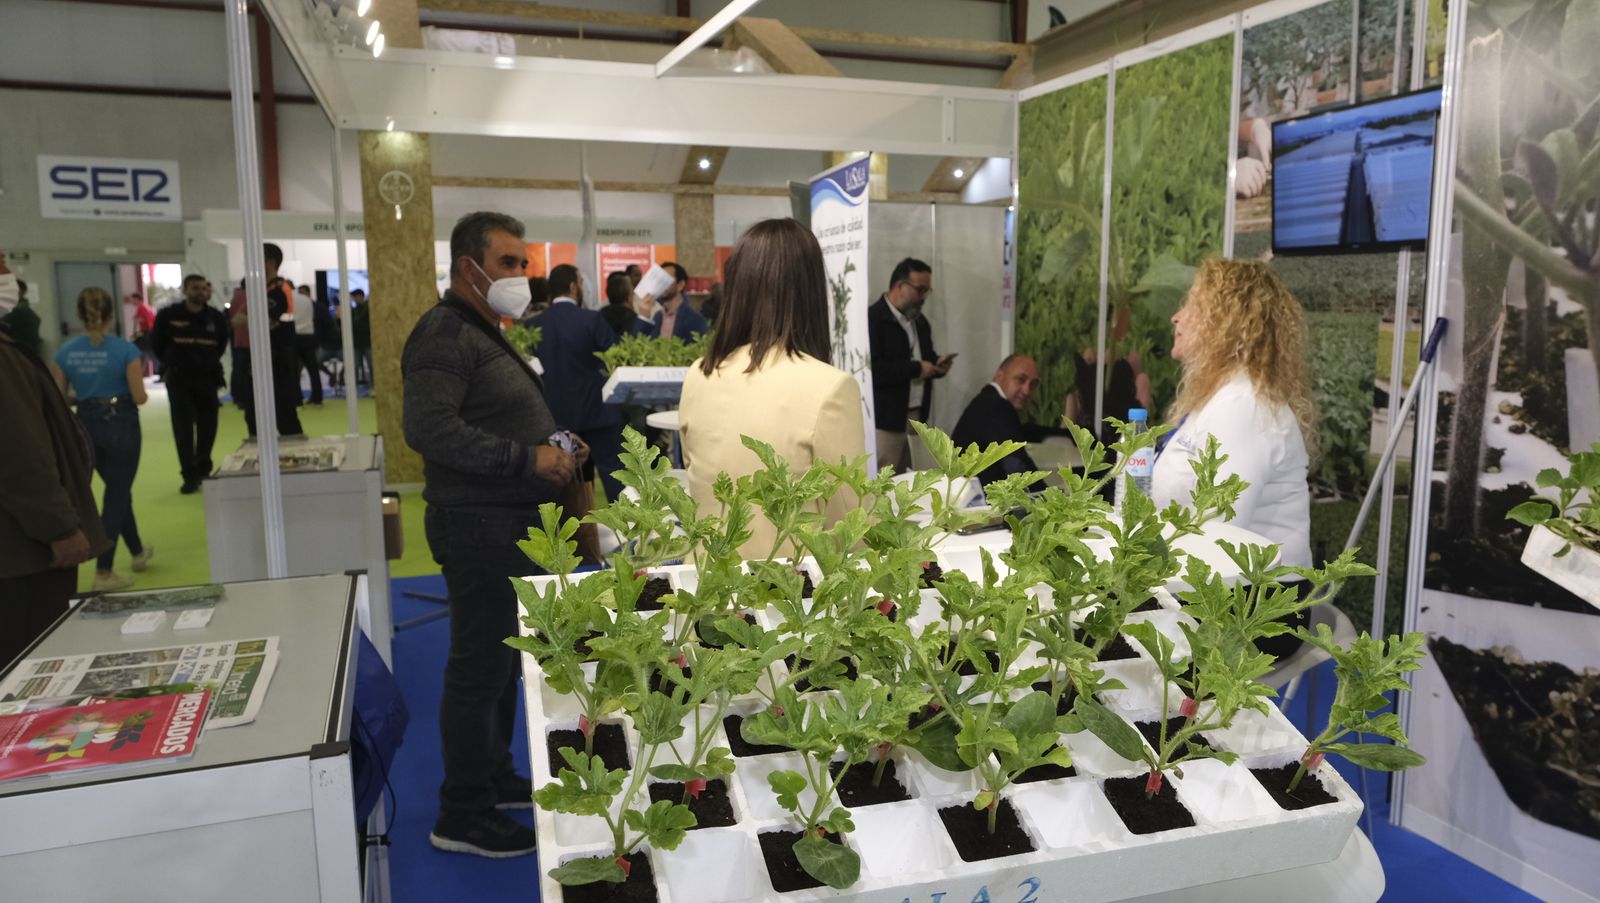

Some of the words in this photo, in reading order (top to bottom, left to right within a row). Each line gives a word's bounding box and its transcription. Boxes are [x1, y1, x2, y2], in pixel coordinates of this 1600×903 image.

[50, 165, 171, 202] SER
[1128, 458, 1147, 466] OYA
[160, 691, 205, 754] MERCADOS
